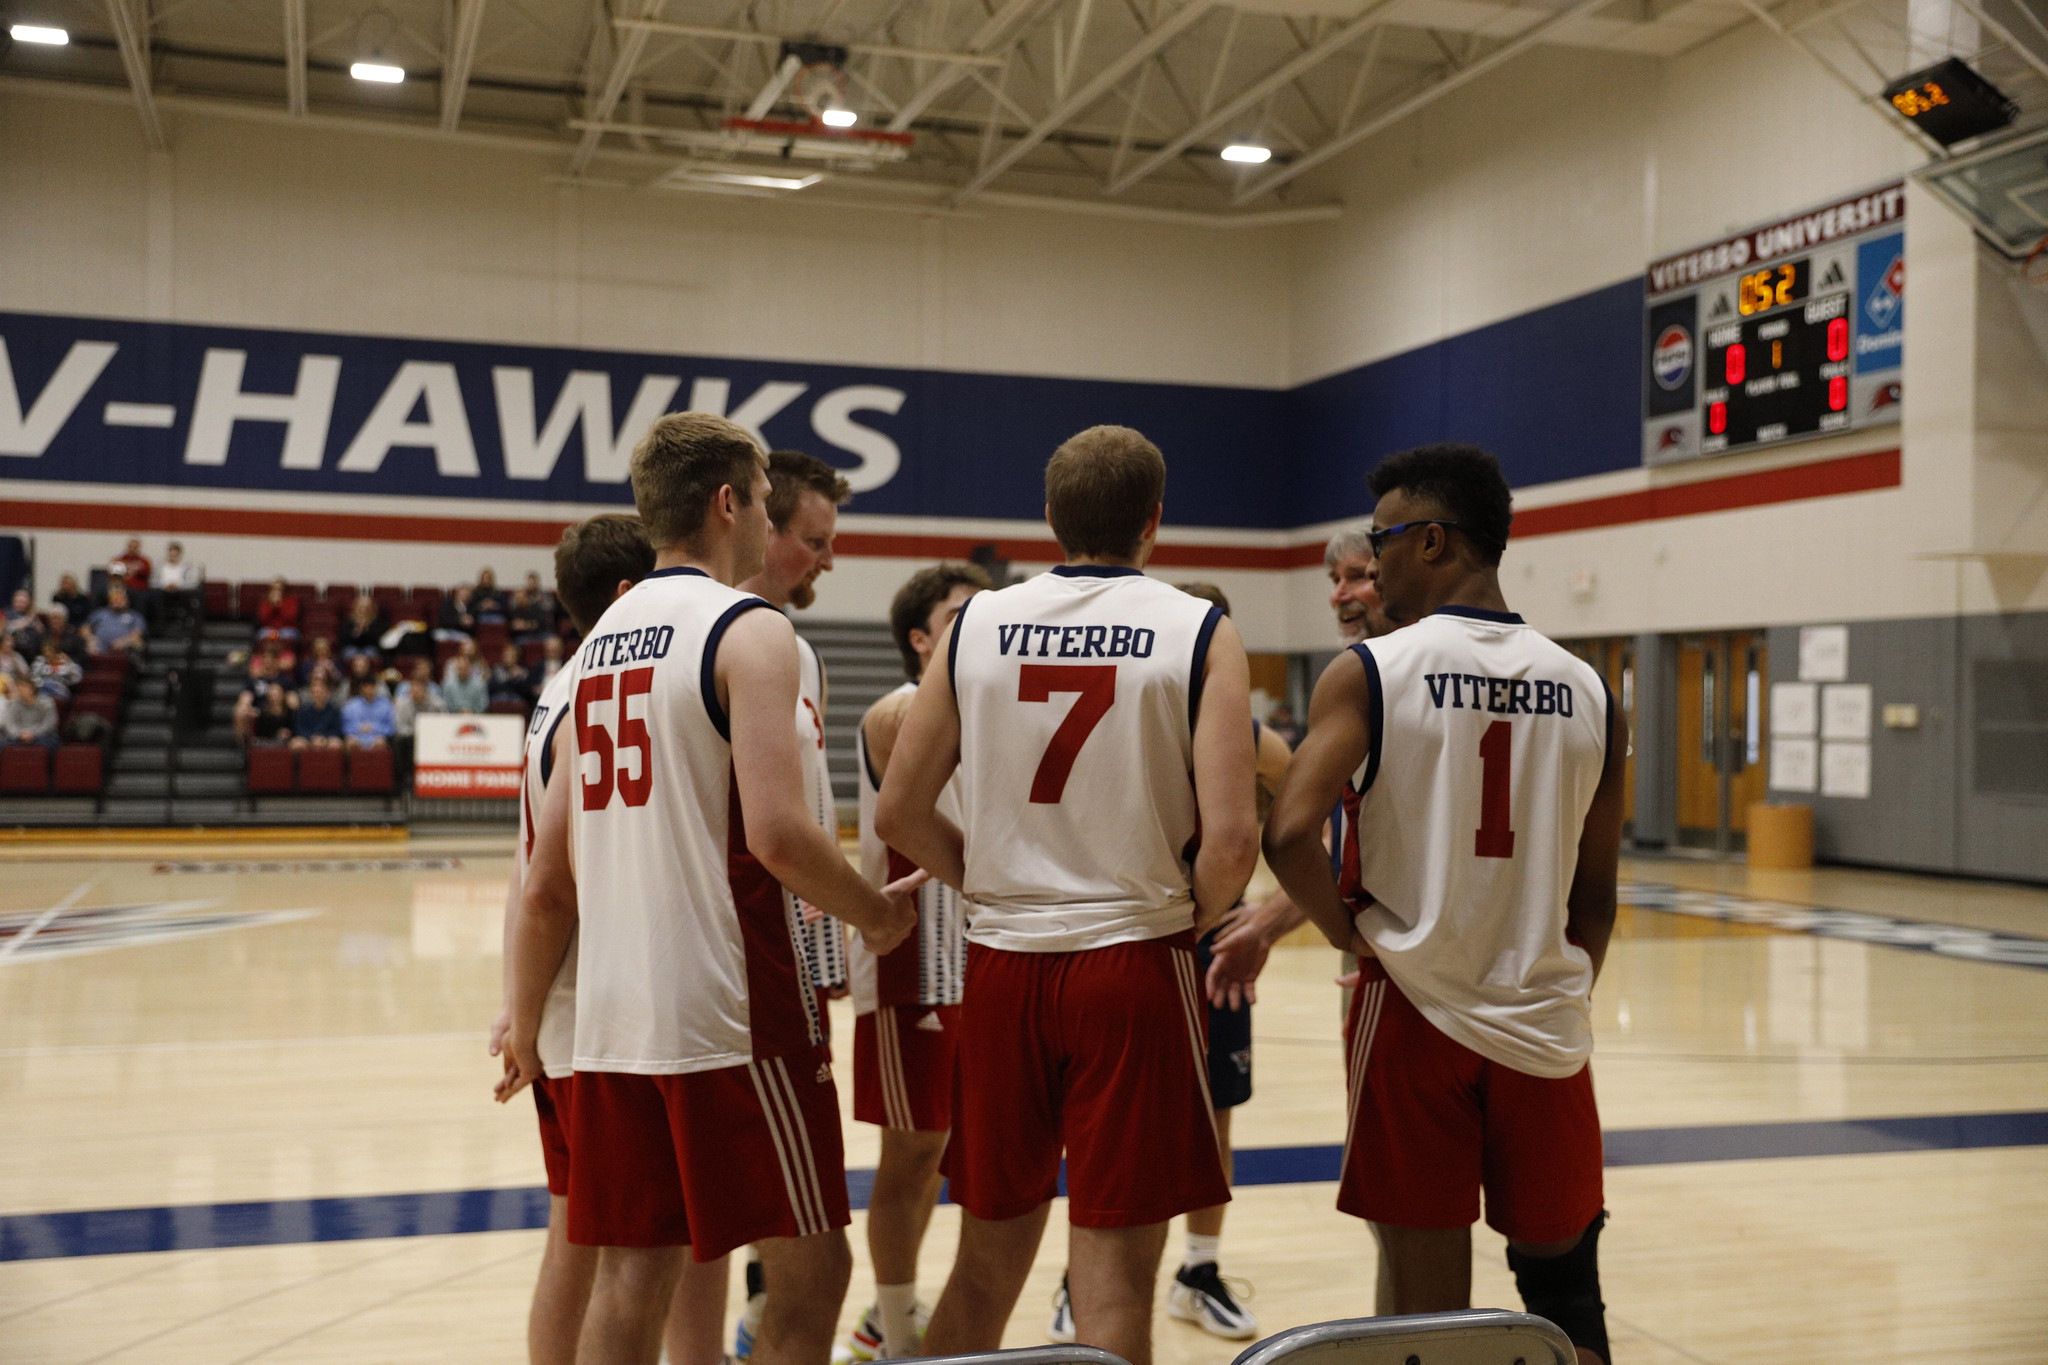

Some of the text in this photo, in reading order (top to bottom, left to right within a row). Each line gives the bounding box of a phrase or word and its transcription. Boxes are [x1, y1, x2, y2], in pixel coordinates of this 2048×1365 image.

[1651, 186, 1904, 291] VITERBO UNIVERSIT
[1827, 317, 1848, 362] 0
[0, 338, 907, 495] V-HAWKS
[580, 625, 675, 674] VITERBO
[998, 624, 1156, 659] VITERBO
[1017, 664, 1118, 804] 7
[1424, 673, 1573, 719] VITERBO
[574, 666, 654, 812] 55
[415, 770, 470, 788] HOME
[1474, 720, 1516, 859] 1
